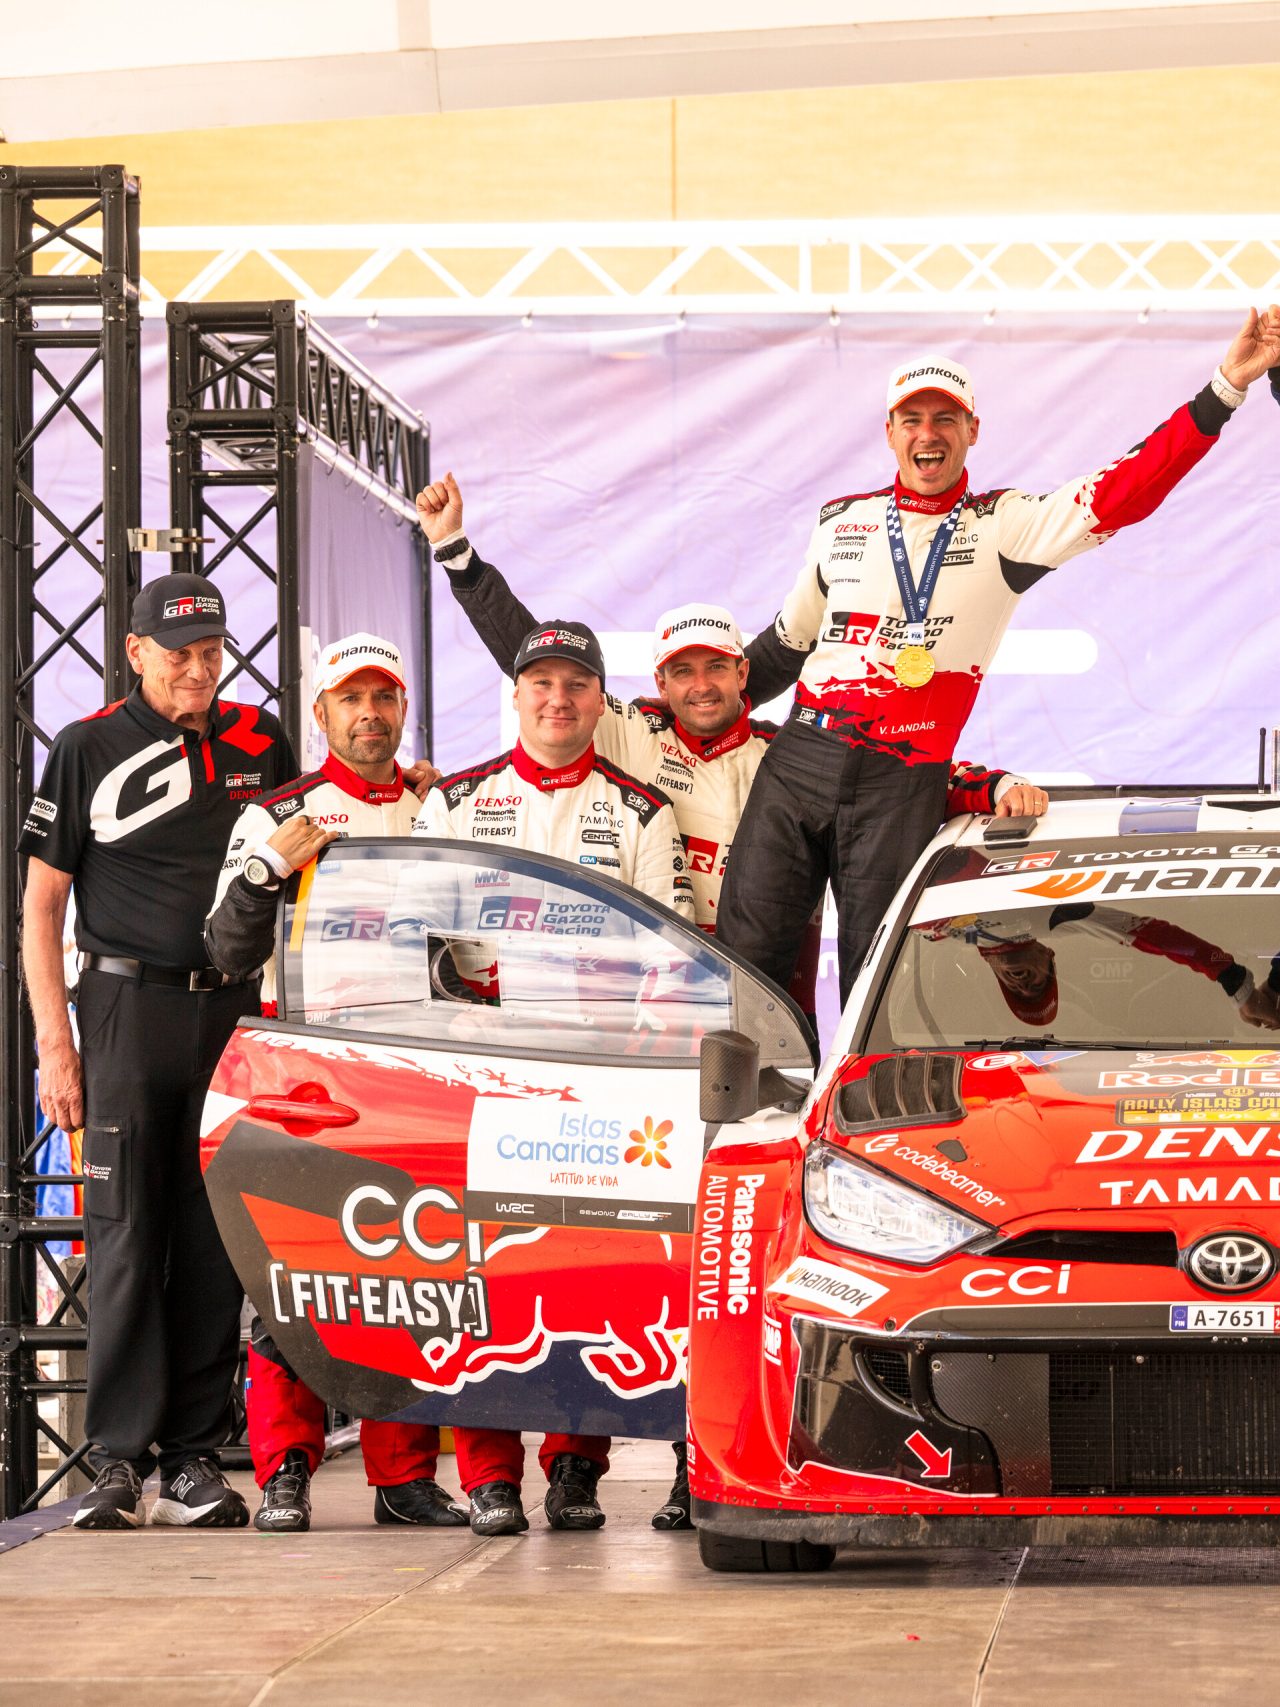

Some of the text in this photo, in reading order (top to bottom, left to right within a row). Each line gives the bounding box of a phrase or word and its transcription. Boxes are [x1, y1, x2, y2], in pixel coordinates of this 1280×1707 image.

[821, 502, 844, 515] OMP
[900, 497, 918, 508] GR
[834, 523, 879, 534] DENSO
[165, 604, 193, 617] GR
[824, 625, 872, 645] GR
[529, 636, 553, 649] GR
[799, 710, 816, 722] OMP
[879, 720, 936, 735] V. LANDAIS
[704, 744, 721, 757] GR
[227, 778, 242, 787] GR
[542, 777, 559, 787] GR
[275, 801, 298, 815] OMP
[474, 795, 523, 808] DENSO
[475, 807, 517, 816] Panasonic
[312, 814, 349, 826] ENSO
[986, 857, 1052, 873] GR
[1067, 846, 1218, 863] TOYOTA
[546, 902, 611, 914] TOYOTA
[480, 909, 534, 929] GR
[543, 914, 606, 925] GAZOO
[322, 919, 382, 940] GR
[542, 924, 602, 937] Racing
[1090, 962, 1133, 979] OMP
[1098, 1069, 1238, 1089] Red
[1124, 1099, 1176, 1110] RALLY
[1182, 1097, 1242, 1109] ISLAS
[558, 1112, 622, 1139] Islas
[497, 1134, 620, 1166] Canarias
[548, 1171, 619, 1187] LATITUD DE VIDA
[894, 1144, 1006, 1208] codebeamer
[495, 1201, 535, 1214] WRC
[579, 1209, 616, 1217] BEYOND
[697, 1175, 728, 1321] AUTOMOTIVE
[726, 1174, 766, 1315] Panasonic
[1194, 1310, 1266, 1327] A-7651
